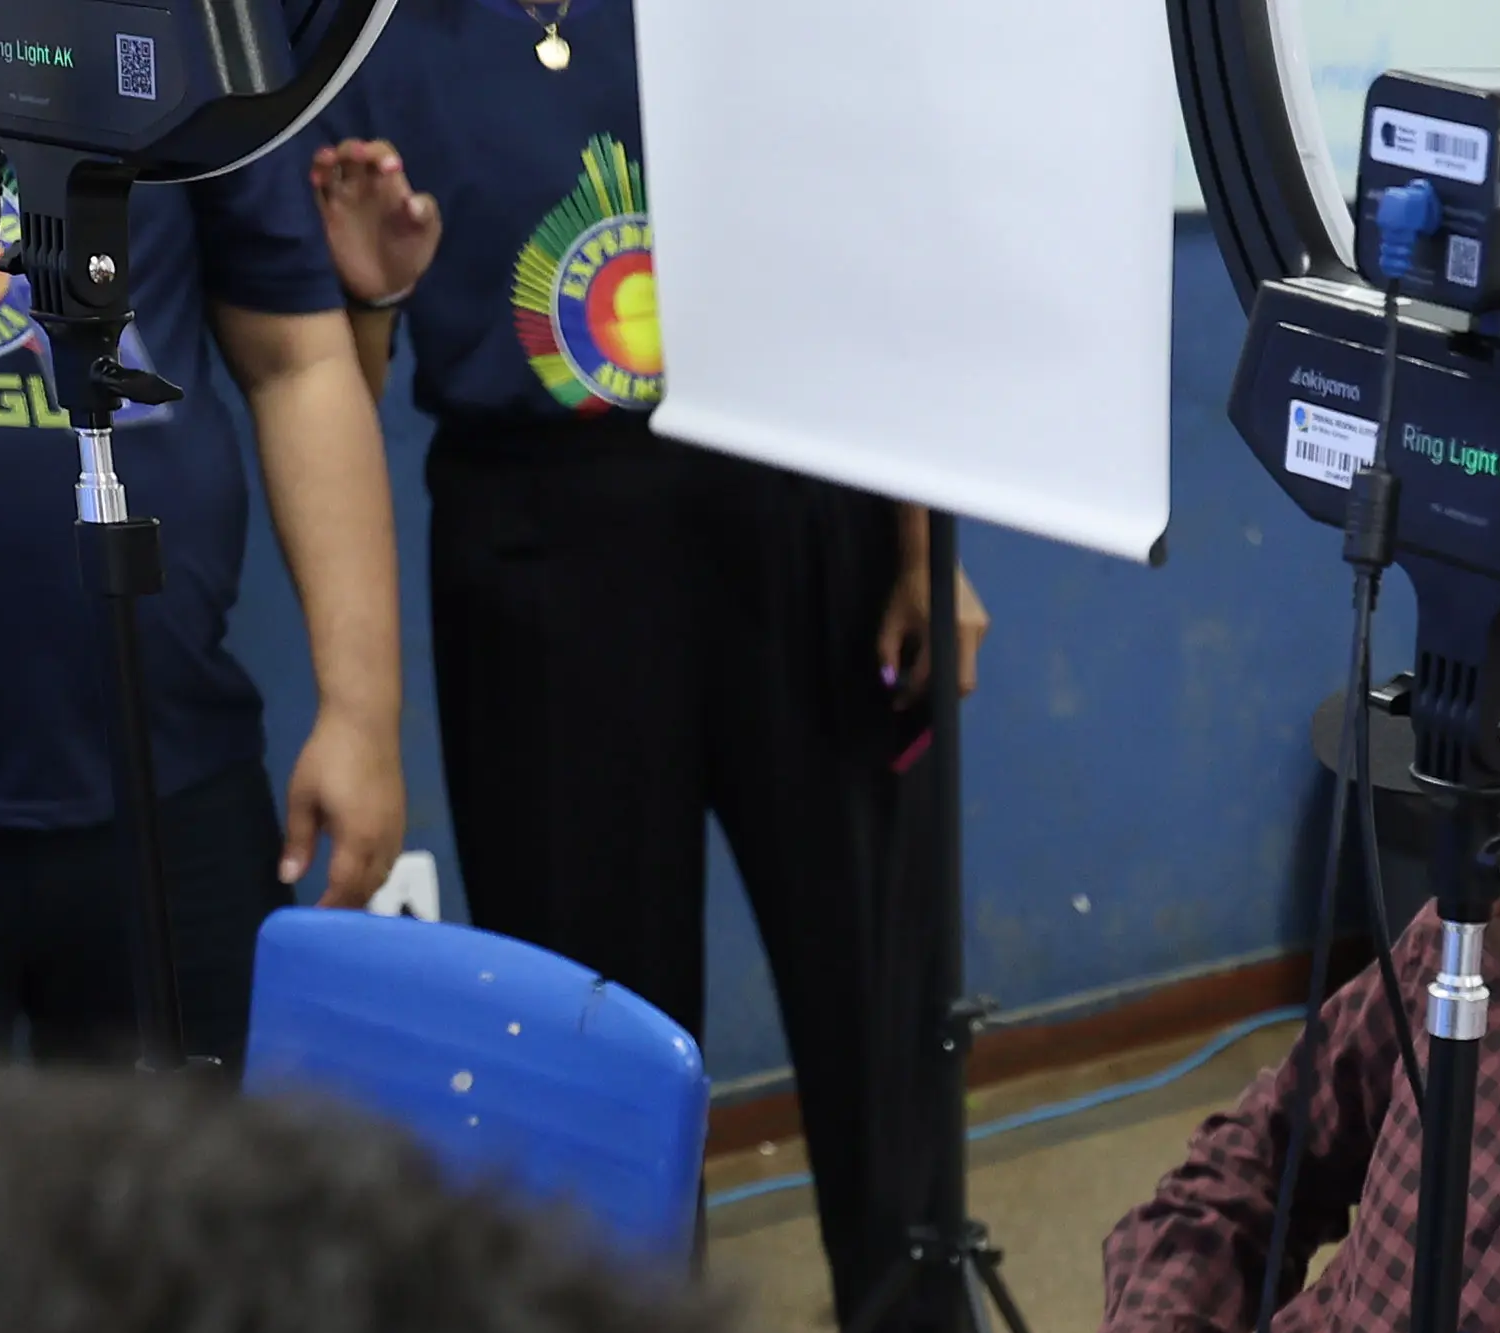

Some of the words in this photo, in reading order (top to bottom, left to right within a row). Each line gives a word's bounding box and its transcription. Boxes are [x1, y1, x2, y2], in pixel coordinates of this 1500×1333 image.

[16, 38, 51, 66] Light
[53, 48, 75, 69] AK
[1301, 370, 1361, 402] akiyama
[1402, 423, 1444, 465] Ring
[1450, 436, 1498, 476] Light
